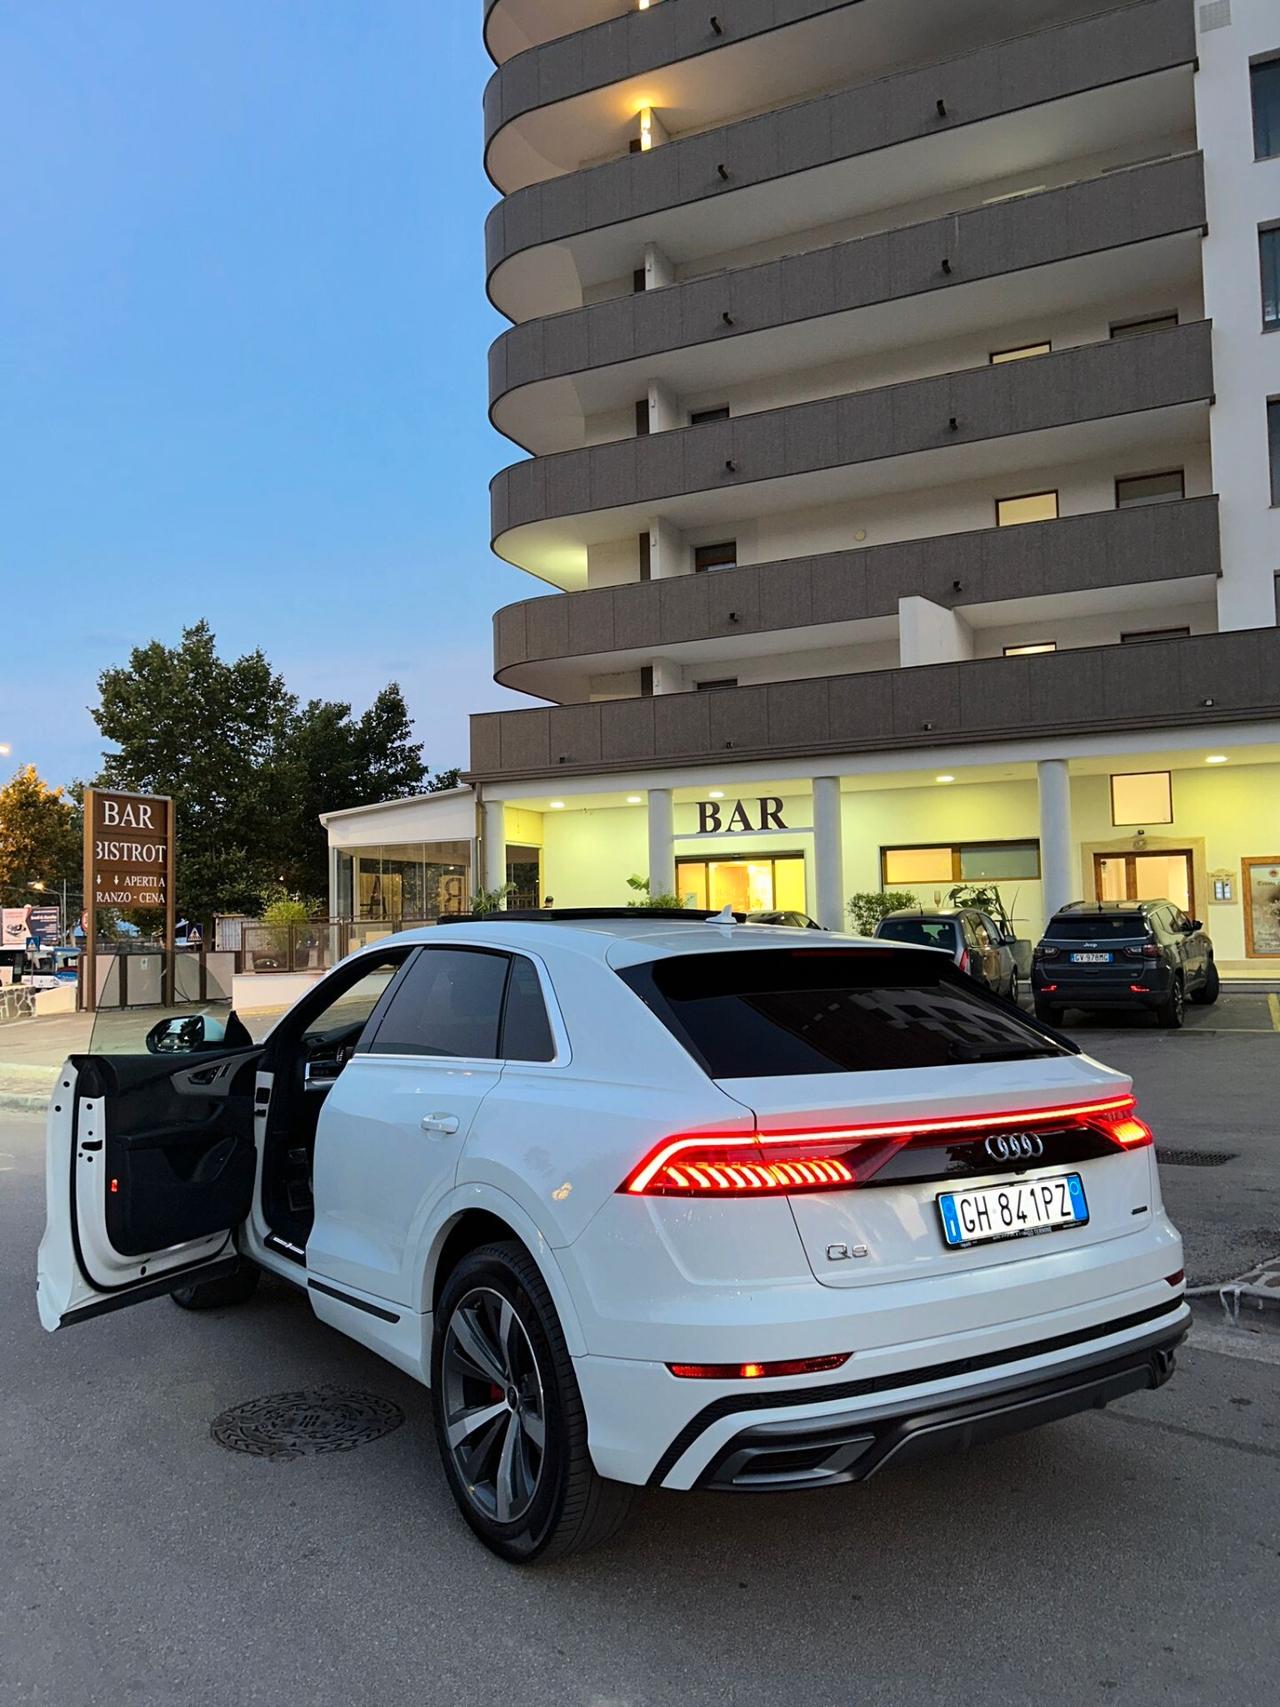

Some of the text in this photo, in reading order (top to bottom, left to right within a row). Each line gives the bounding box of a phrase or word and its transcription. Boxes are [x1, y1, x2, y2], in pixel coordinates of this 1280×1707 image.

[103, 801, 154, 829] BAR
[696, 797, 788, 834] BAR
[96, 841, 166, 863] BISTROT
[124, 875, 165, 888] APERTI A
[139, 892, 165, 903] CENA
[960, 1195, 992, 1233] GH
[998, 1183, 1071, 1226] 841PZ
[827, 1243, 868, 1261] Q8
